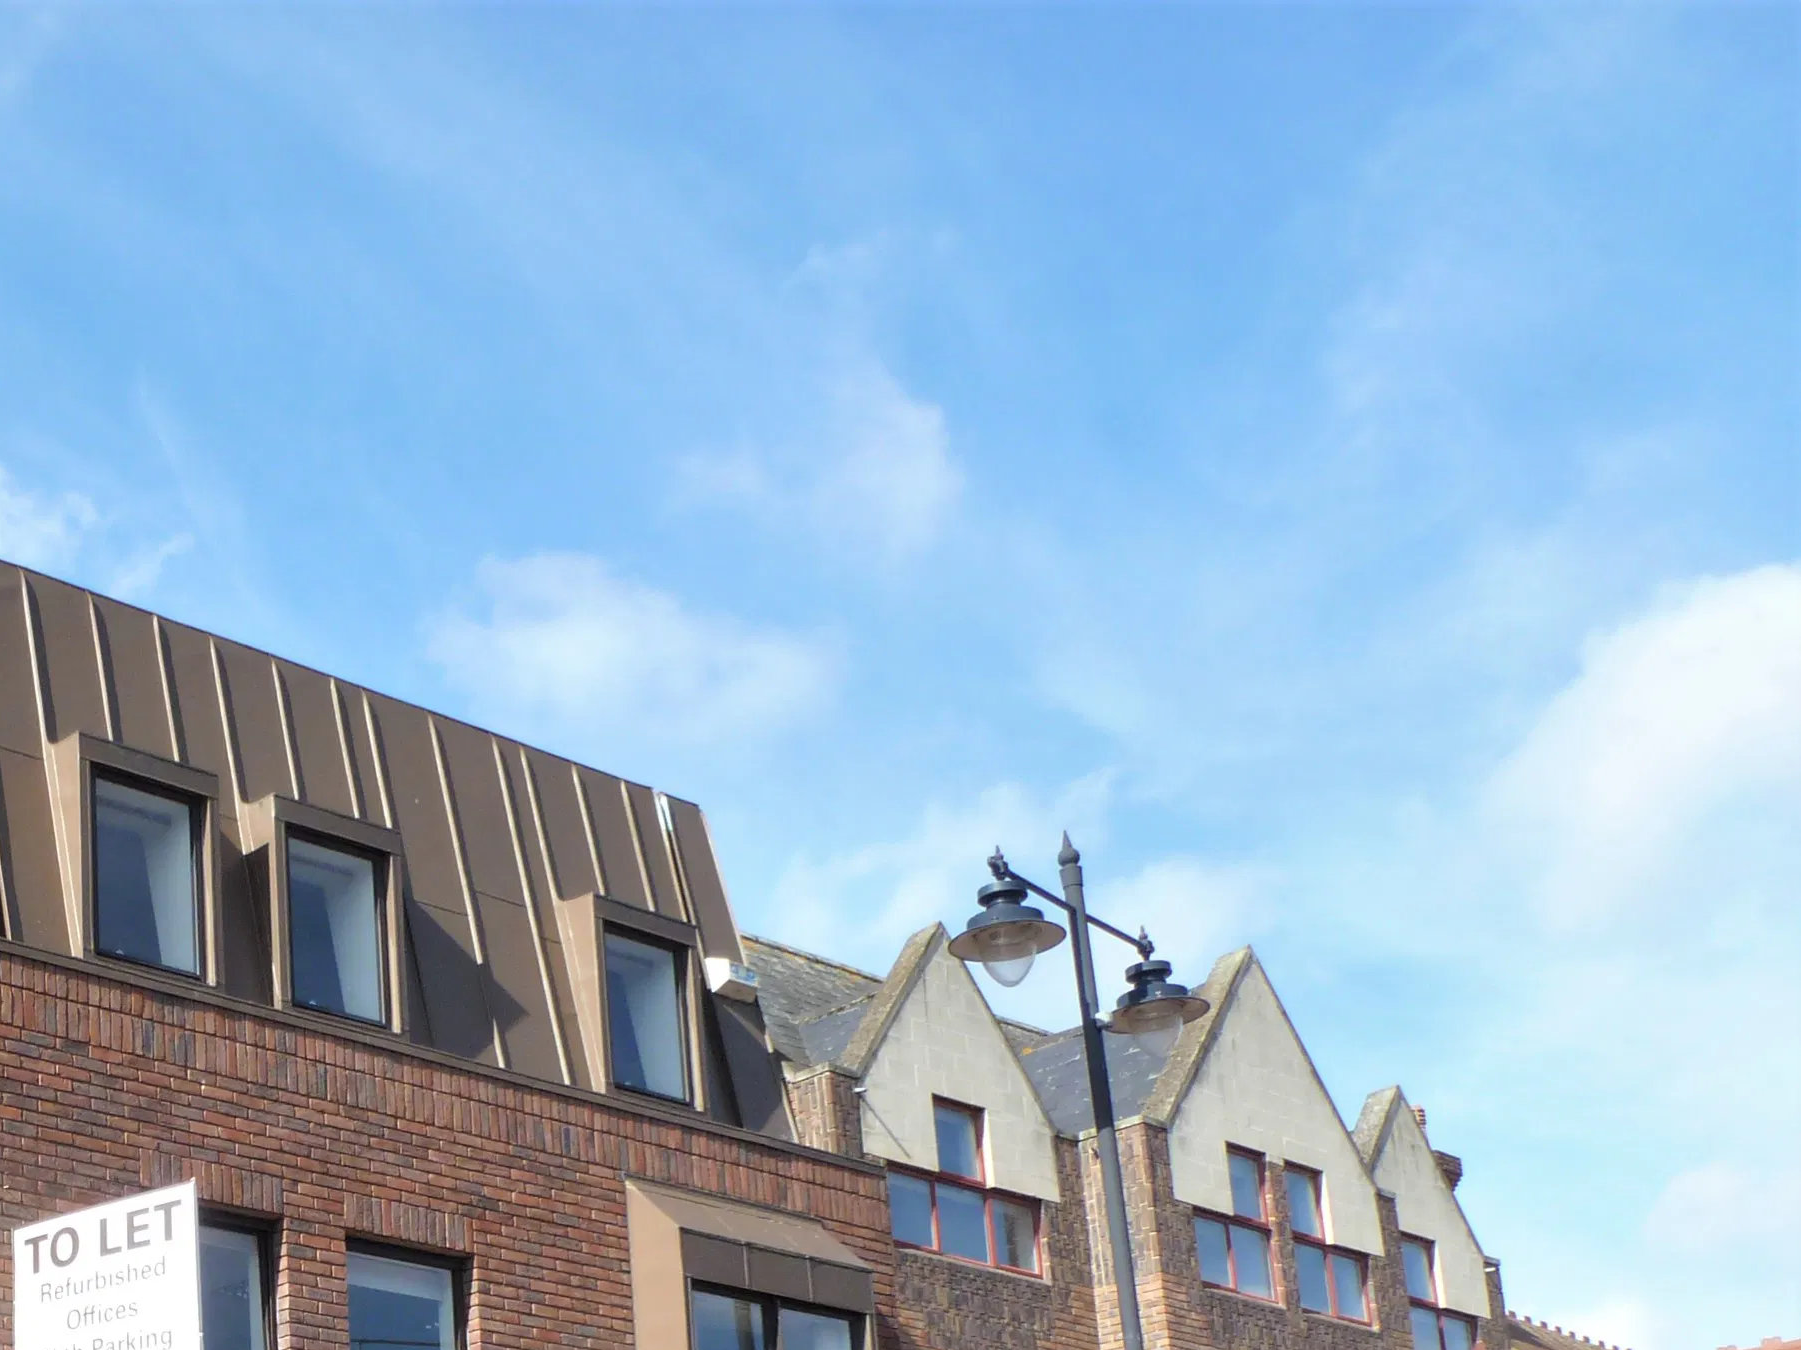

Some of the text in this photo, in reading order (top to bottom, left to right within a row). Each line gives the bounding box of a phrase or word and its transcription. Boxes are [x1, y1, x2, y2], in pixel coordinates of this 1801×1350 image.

[24, 1199, 182, 1275] TO LET
[40, 1256, 166, 1303] Refurbished
[66, 1302, 139, 1330] Offices
